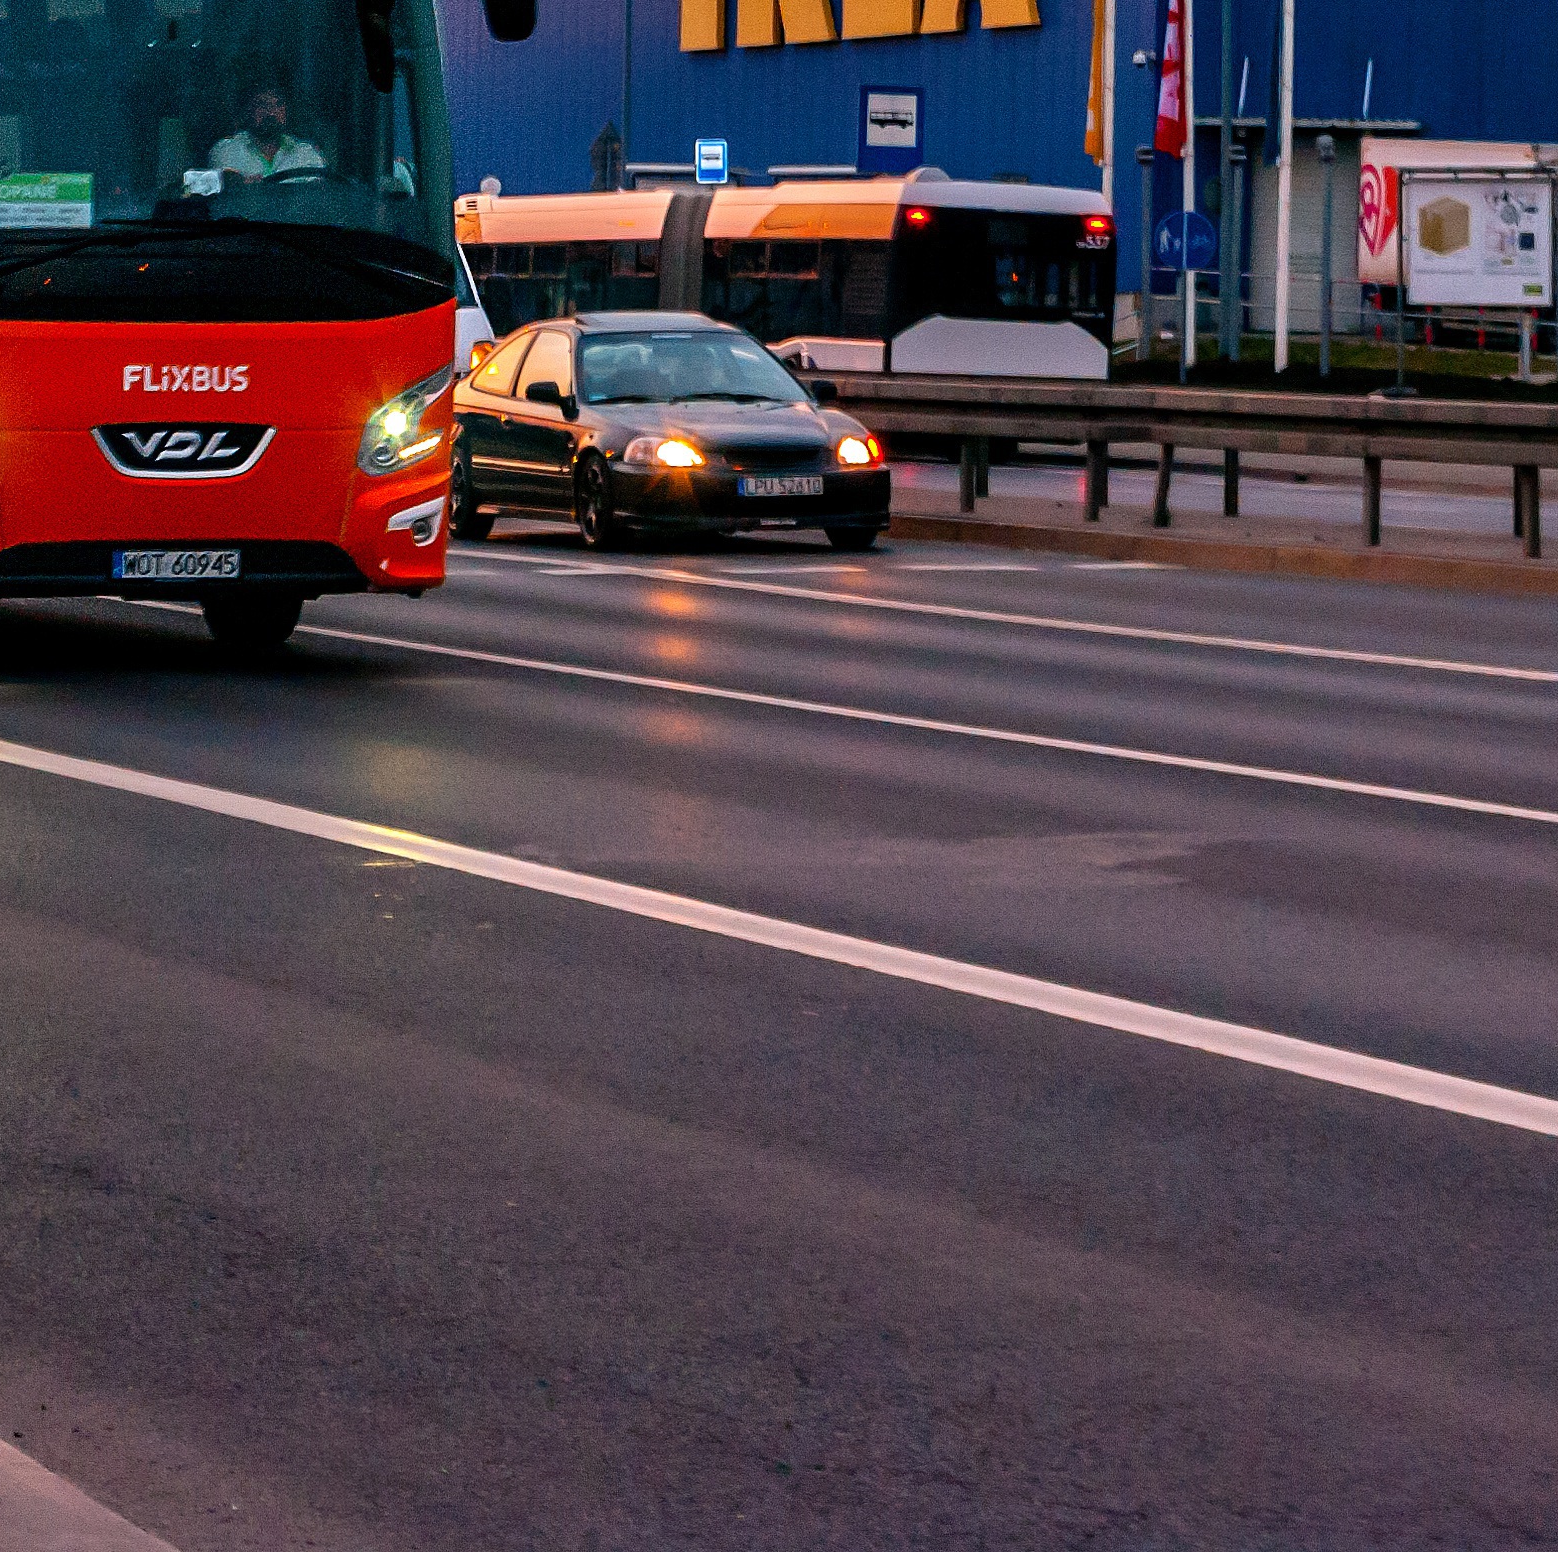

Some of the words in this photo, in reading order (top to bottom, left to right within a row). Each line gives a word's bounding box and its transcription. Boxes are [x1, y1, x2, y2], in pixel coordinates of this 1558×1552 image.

[121, 430, 240, 461] VDL
[124, 552, 165, 576] WOT
[171, 552, 238, 576] 60945
